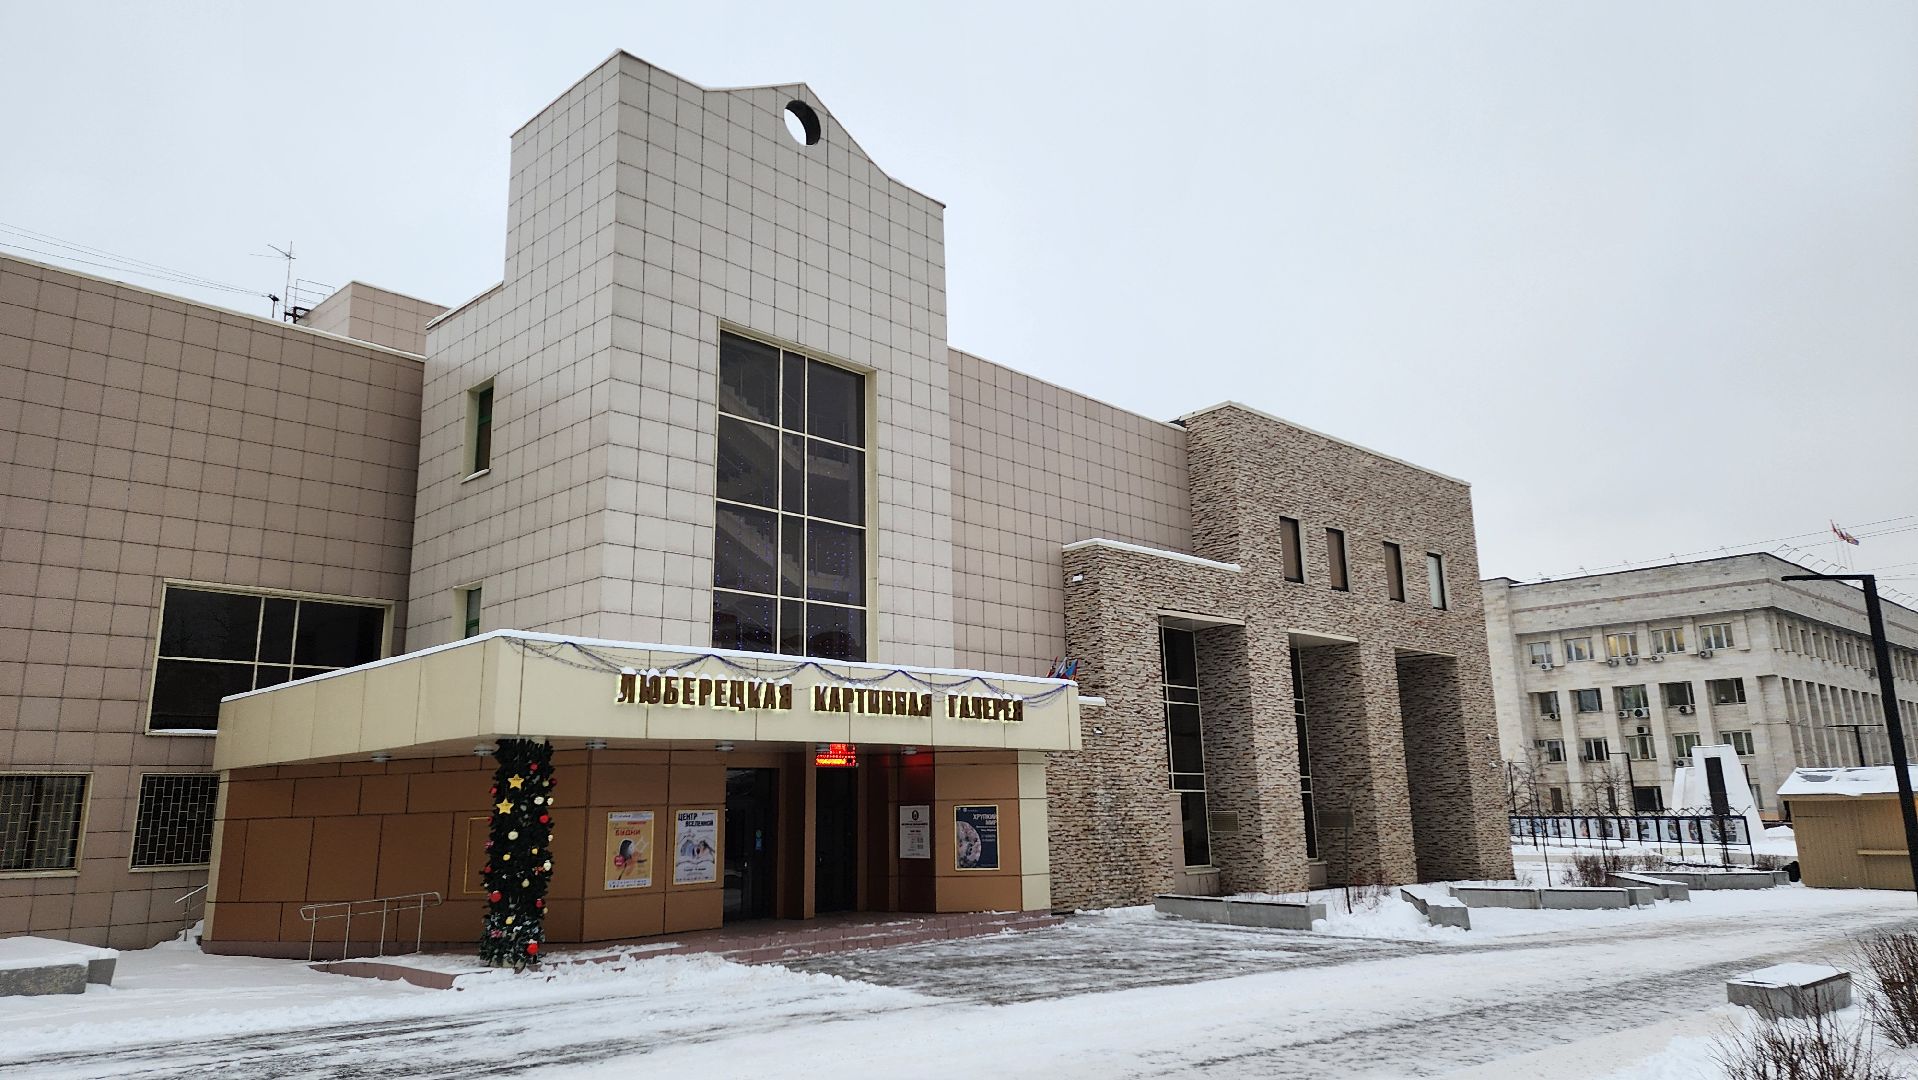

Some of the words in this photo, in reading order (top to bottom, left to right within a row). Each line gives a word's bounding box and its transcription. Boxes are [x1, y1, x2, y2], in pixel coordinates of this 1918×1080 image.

[617, 671, 792, 712] ЛЮБЕРЕЦКАЯ
[814, 684, 932, 717] КАРТИННАЯ
[947, 694, 1023, 722] ГАЛЕРЕЯ
[678, 812, 697, 821] ЦЕНТР
